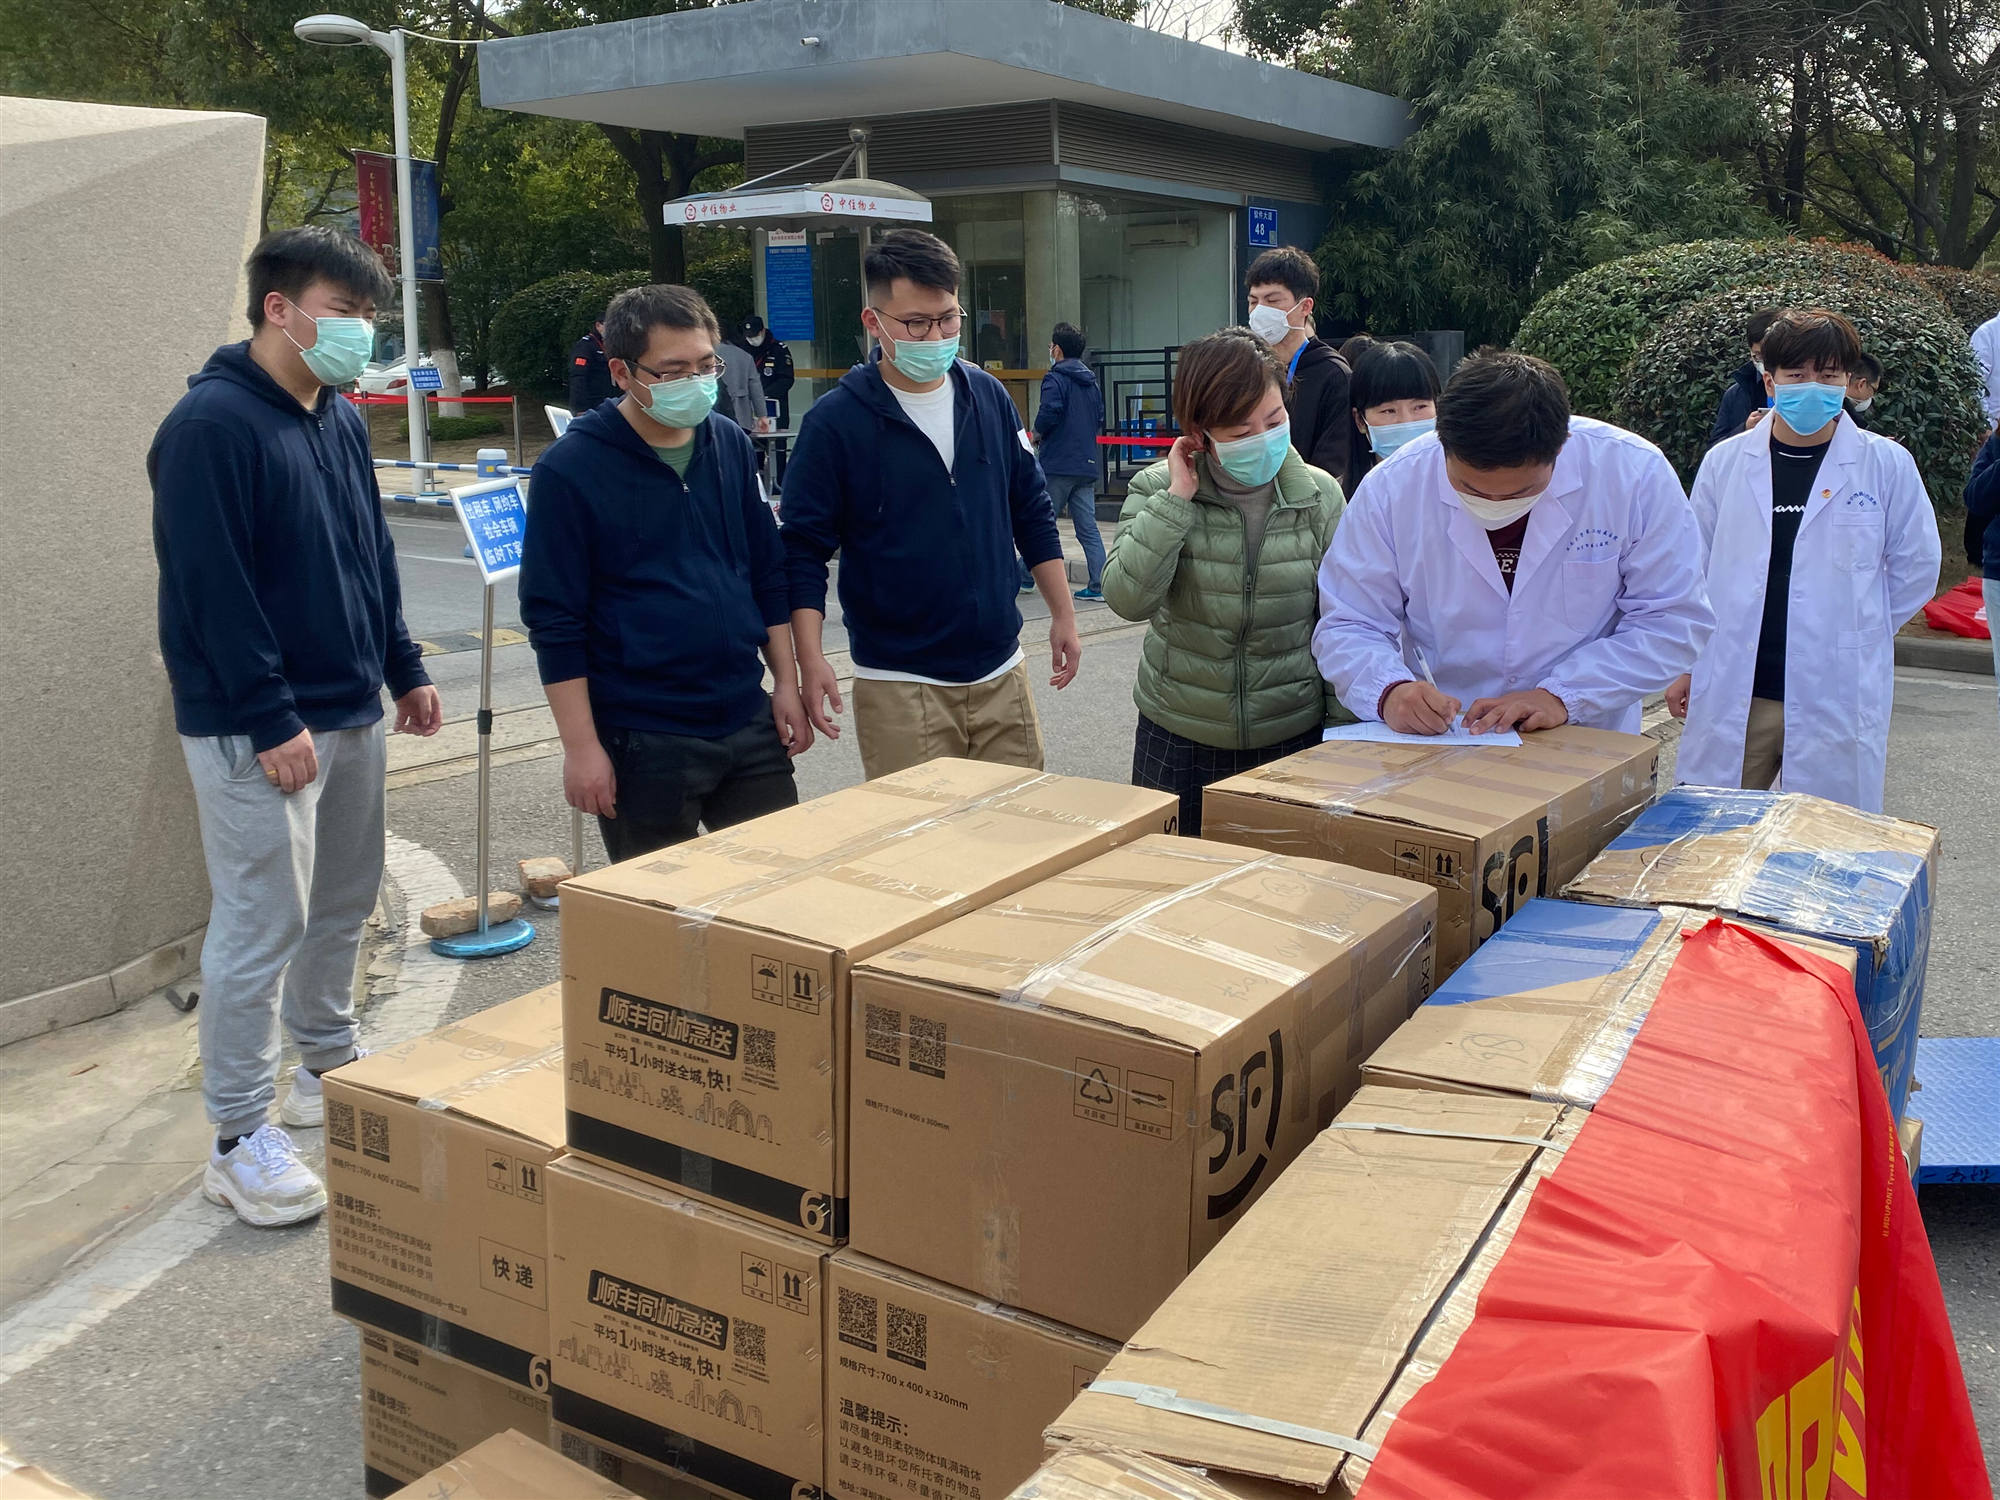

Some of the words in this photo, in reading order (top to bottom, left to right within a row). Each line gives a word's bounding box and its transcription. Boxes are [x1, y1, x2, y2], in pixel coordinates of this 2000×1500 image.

[701, 203, 737, 215] 中住物业
[839, 198, 877, 211] 中住物业
[1255, 223, 1265, 235] 48
[482, 517, 518, 540] 社会车辆
[483, 540, 522, 566] 临时下客
[603, 993, 733, 1056] 顺丰同城急送
[1208, 1050, 1267, 1175] SF
[800, 1190, 825, 1233] 6
[492, 1254, 534, 1289] 快递
[593, 1276, 722, 1346] 顺丰同城急送
[528, 1356, 550, 1394] 6
[899, 1380, 905, 1388] x
[906, 1380, 924, 1395] 400
[925, 1388, 931, 1397] x
[932, 1389, 969, 1411] 320mm
[839, 1397, 908, 1437] 温馨提示:
